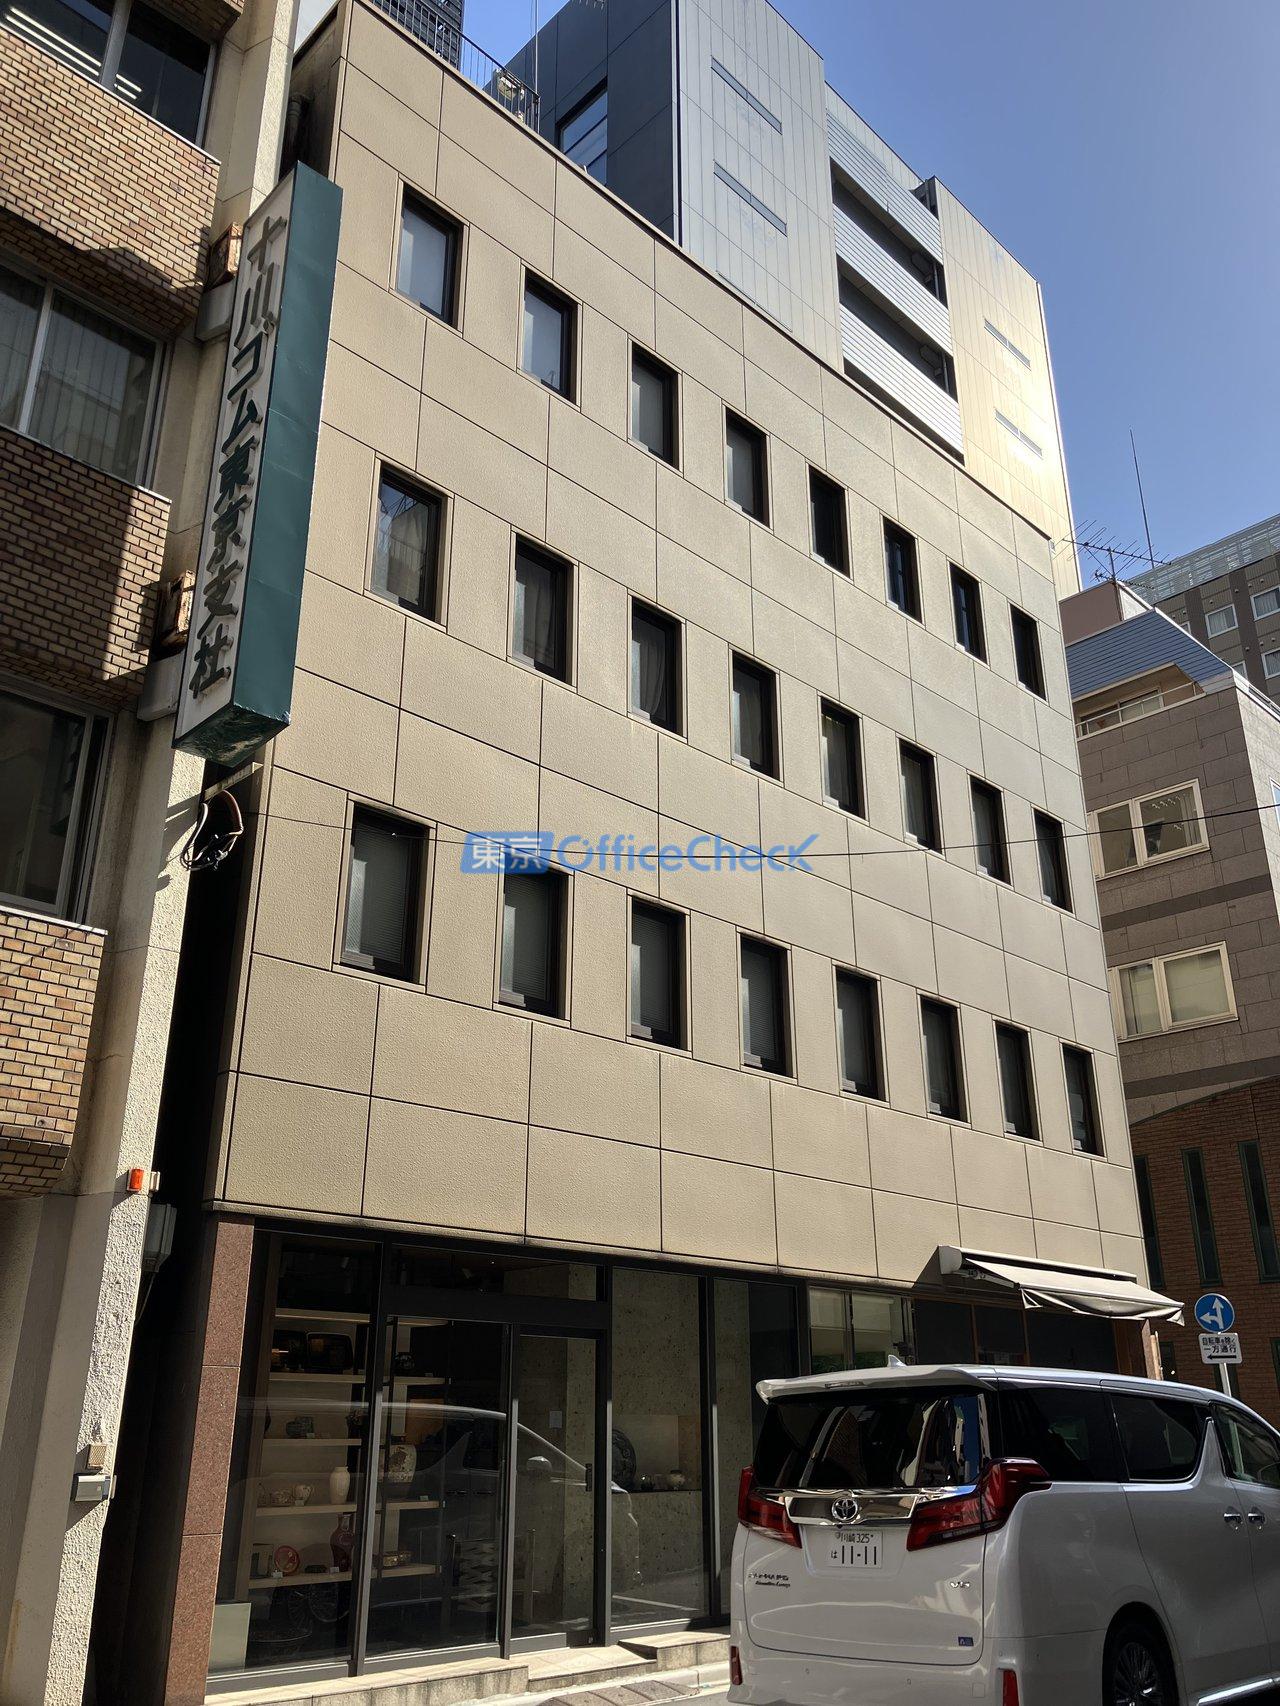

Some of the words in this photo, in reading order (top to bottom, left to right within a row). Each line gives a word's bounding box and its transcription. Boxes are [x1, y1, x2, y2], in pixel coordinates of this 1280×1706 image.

[1203, 1345, 1237, 1354] 一方通行
[841, 1545, 877, 1565] 11-11
